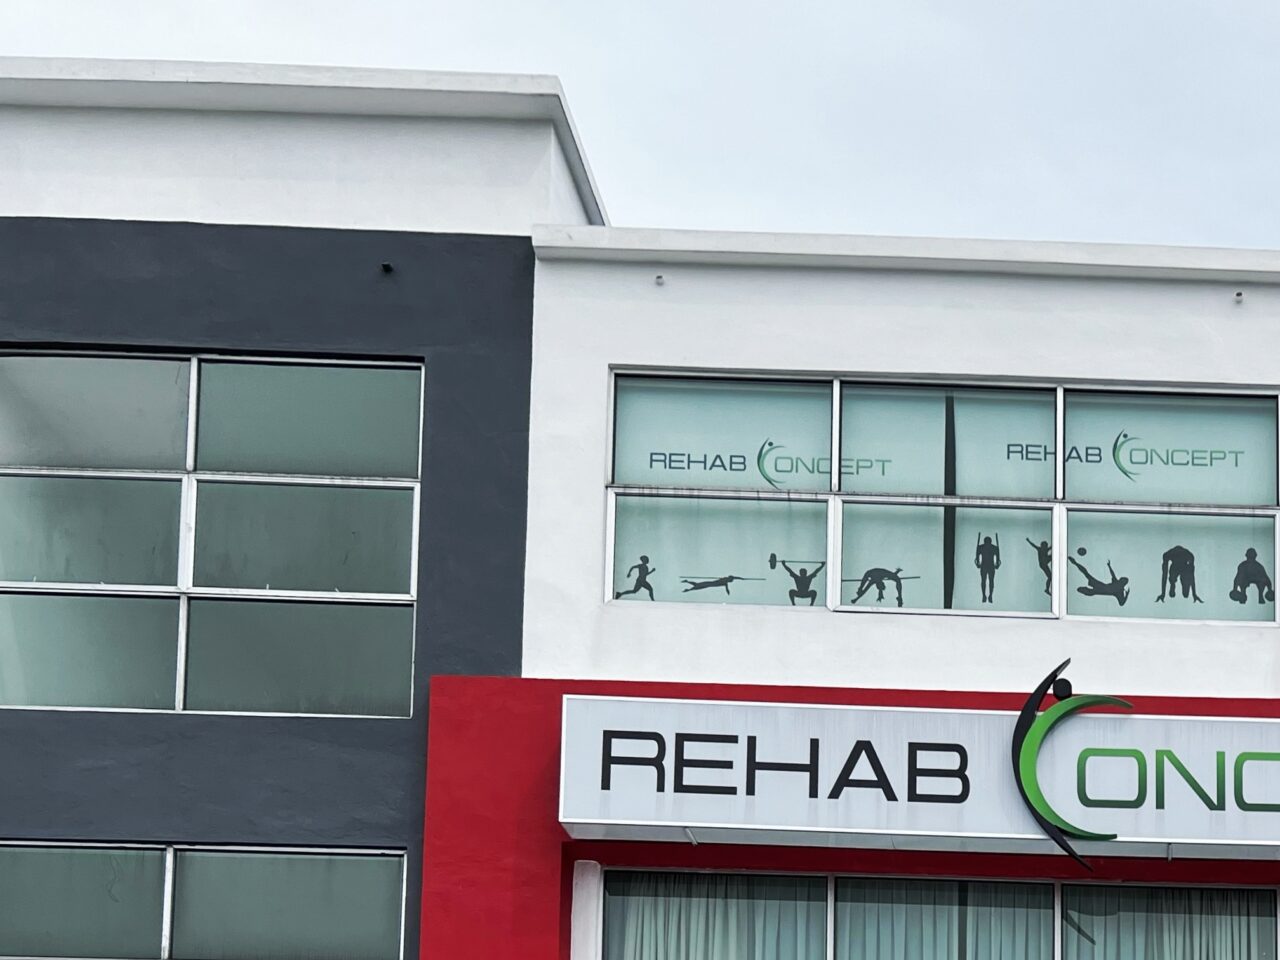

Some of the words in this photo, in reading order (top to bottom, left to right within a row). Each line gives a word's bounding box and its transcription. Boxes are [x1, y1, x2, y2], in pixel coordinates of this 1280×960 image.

[650, 452, 747, 472] REHAB
[1007, 443, 1102, 463] REHAB
[600, 729, 970, 805] REHAB
